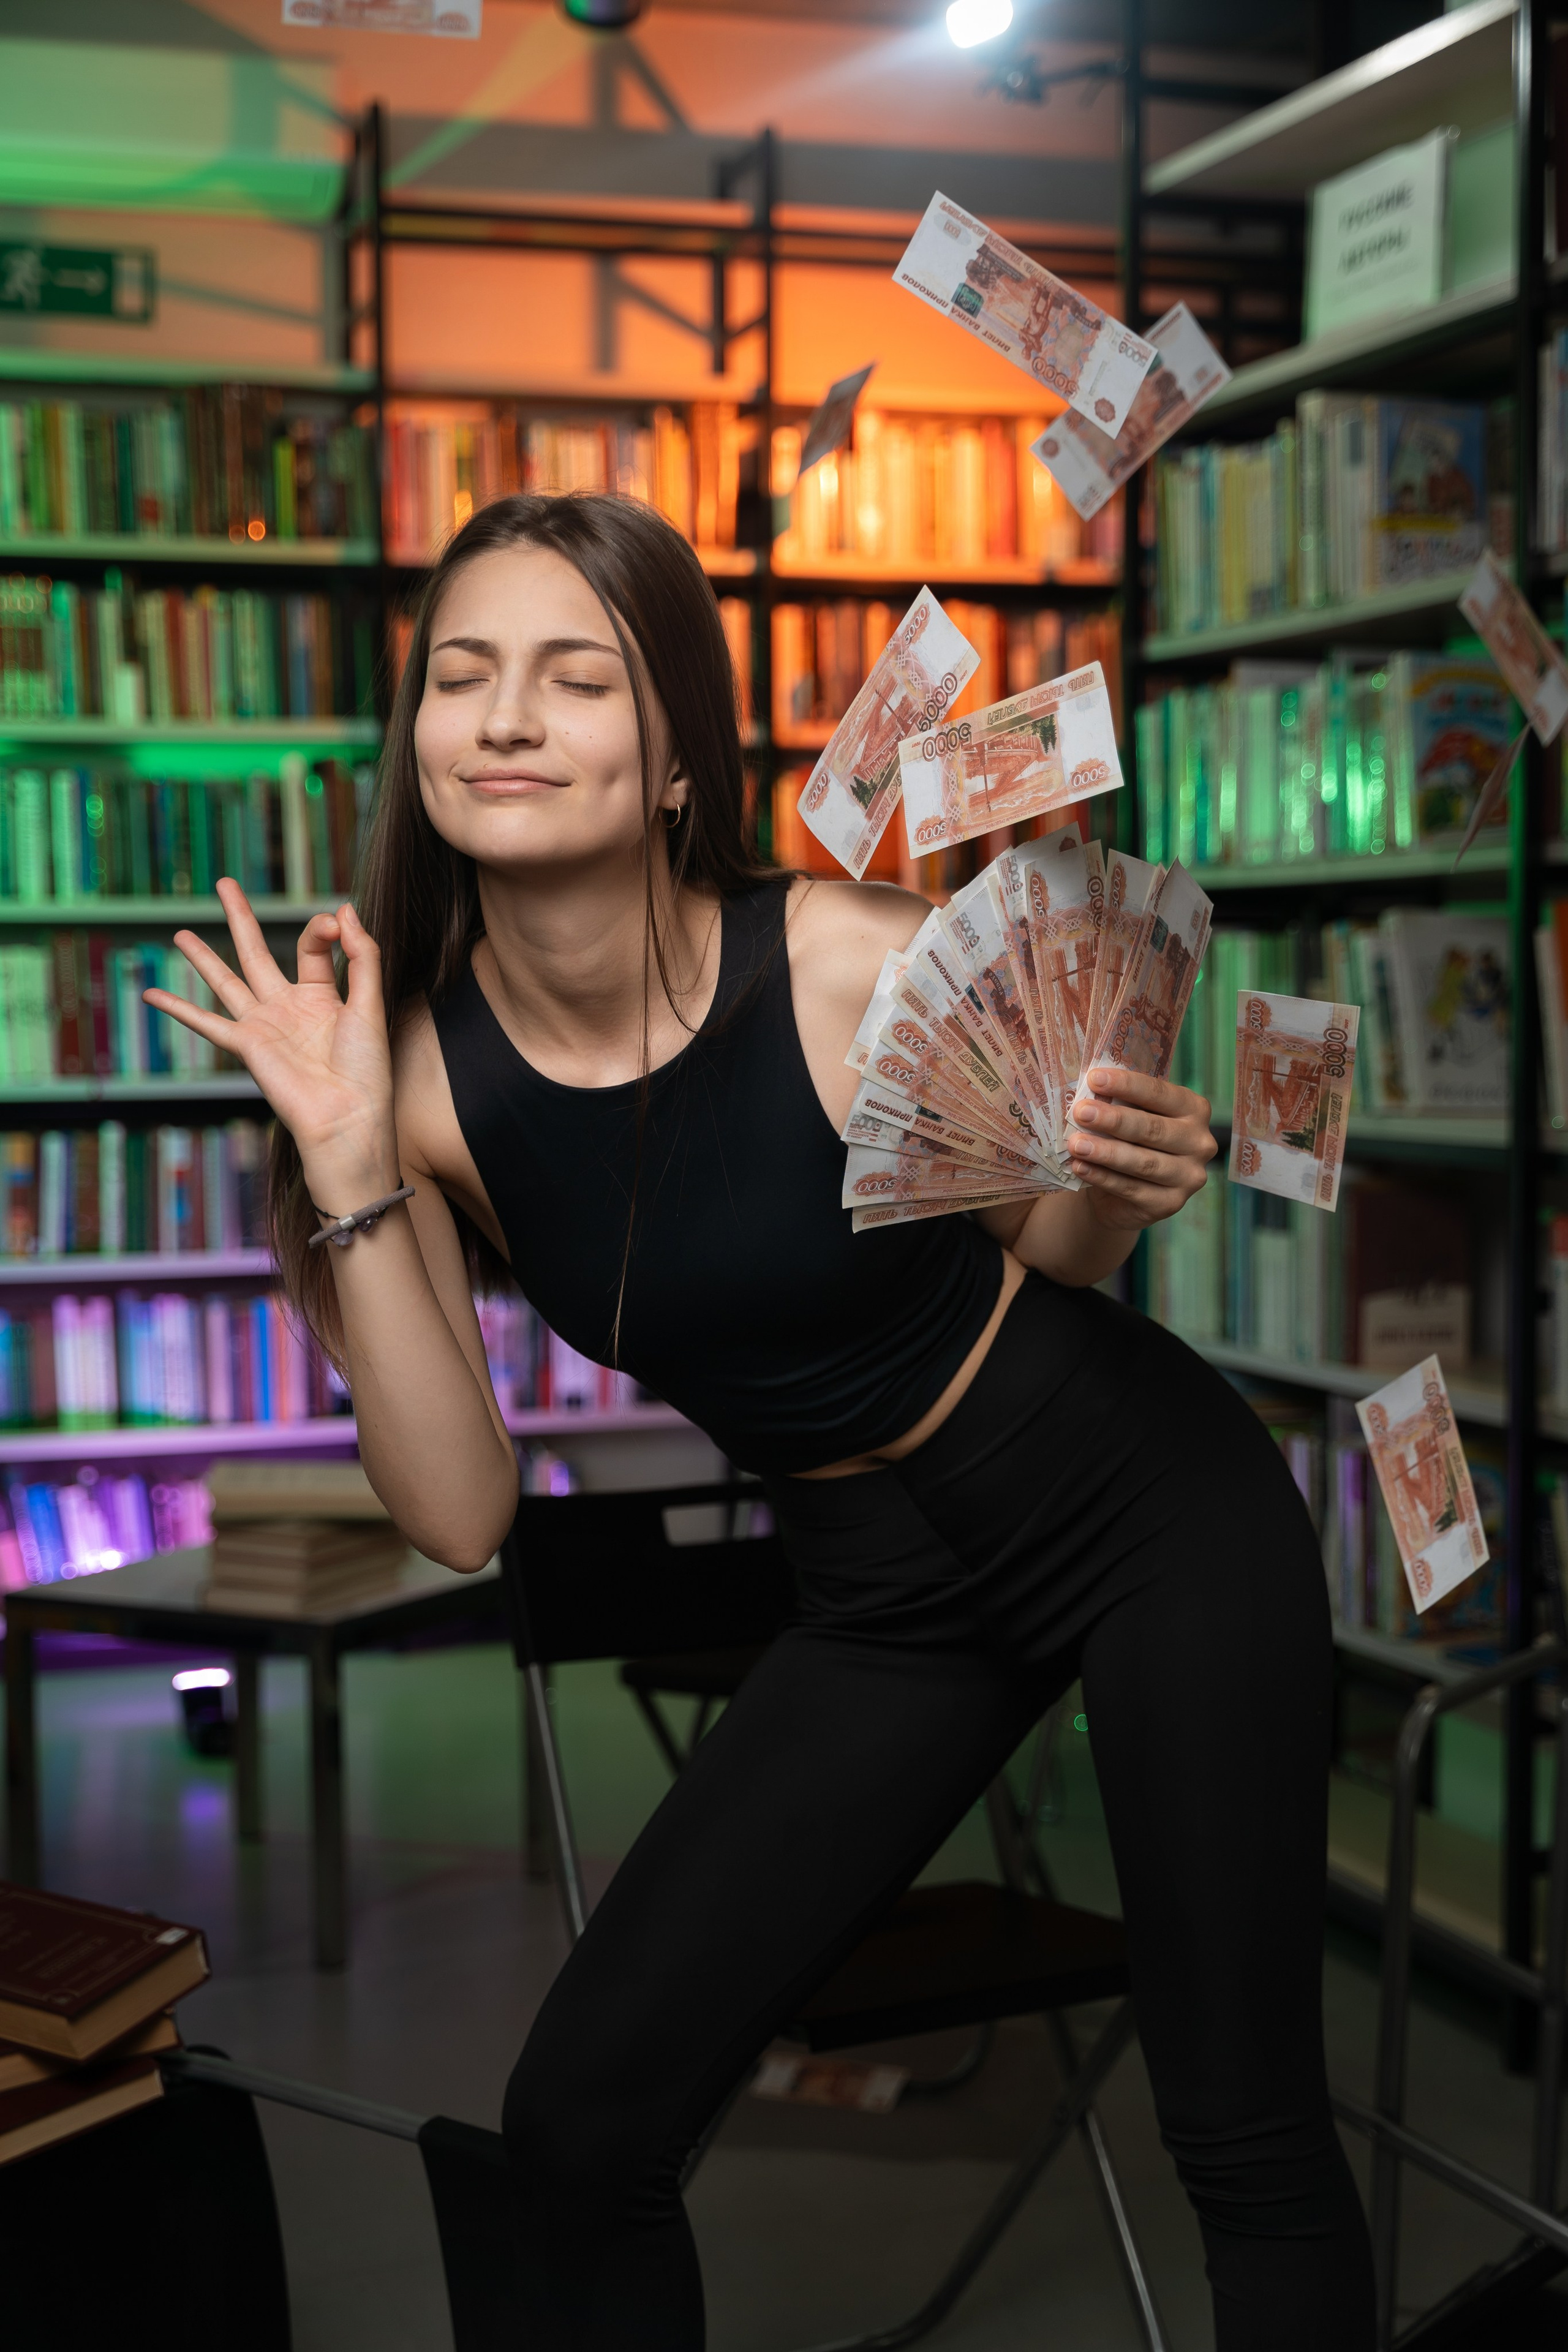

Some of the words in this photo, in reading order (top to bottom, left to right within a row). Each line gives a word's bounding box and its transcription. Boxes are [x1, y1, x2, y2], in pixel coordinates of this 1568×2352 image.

[901, 273, 949, 309] ПРИКОЛОВ
[951, 307, 981, 331] БАНКА
[982, 330, 1011, 353] БИЛЕТ
[1031, 356, 1080, 400] 5000
[903, 607, 926, 645] 5000
[1030, 684, 1064, 708] ТЫСЯЧ
[1068, 671, 1095, 692] ПЯТЬ
[917, 672, 958, 733] 5000
[987, 697, 1028, 726] ДУБЛЕЙ
[922, 722, 972, 762] 5000
[1072, 765, 1107, 787] 5000
[807, 773, 827, 810] 5000
[853, 837, 871, 870] ПЯТЬ
[868, 797, 891, 837] ТЫСЯЧ
[918, 821, 947, 843] 5000
[1011, 854, 1023, 892] 5000
[1031, 877, 1046, 919] 5000
[1112, 867, 1123, 910] 5000
[960, 911, 980, 948] 5000
[1133, 949, 1144, 983] БИЛЕТ
[1143, 914, 1155, 948] БАНКА
[927, 949, 962, 997] ПРИКОЛОВ
[960, 997, 983, 1028] БАНКА
[1029, 988, 1044, 1025] ПЯТЬ
[1250, 1000, 1262, 1030] 5000
[895, 1027, 929, 1055] 5000
[901, 989, 929, 1019] ПЯТЬ
[929, 1017, 965, 1054] ТЫСЯЧ
[958, 1050, 1001, 1093] ДУБЛЕЙ
[981, 1028, 1003, 1057] БИЛЕТ
[1108, 1008, 1133, 1066] 5000
[1007, 1032, 1027, 1065] ПЯТЬ
[1024, 1064, 1049, 1103] ТЫСЯЧ
[1322, 1028, 1348, 1079] 5000
[880, 1061, 916, 1084] 5000
[865, 1099, 913, 1123] ПРИКОЛОВ
[954, 1089, 974, 1106] СРЕДСТВОМ
[851, 1115, 883, 1132] 5000
[914, 1117, 945, 1134] БАНКА
[947, 1111, 969, 1125] СРЕДСТВОМ
[973, 1104, 994, 1121] ПЛАТЕЖНЫМ
[992, 1120, 1009, 1134] ЯВЛЯЕТСЯ
[1328, 1092, 1343, 1136] ДУБЛЕЙ
[946, 1131, 976, 1146] БИЛЕТ
[968, 1121, 992, 1136] ПЛАТЕЖНЫМ
[990, 1133, 1009, 1145] ЯВЛЯЕТСЯ
[1241, 1142, 1254, 1177] 5000
[1324, 1135, 1338, 1170] ТЫСЯЧ
[858, 1179, 897, 1193] 5000
[1320, 1174, 1333, 1202] ПЯТЬ
[862, 1208, 898, 1224] ПЯТЬ
[903, 1200, 948, 1216] ТЫСЯЧ
